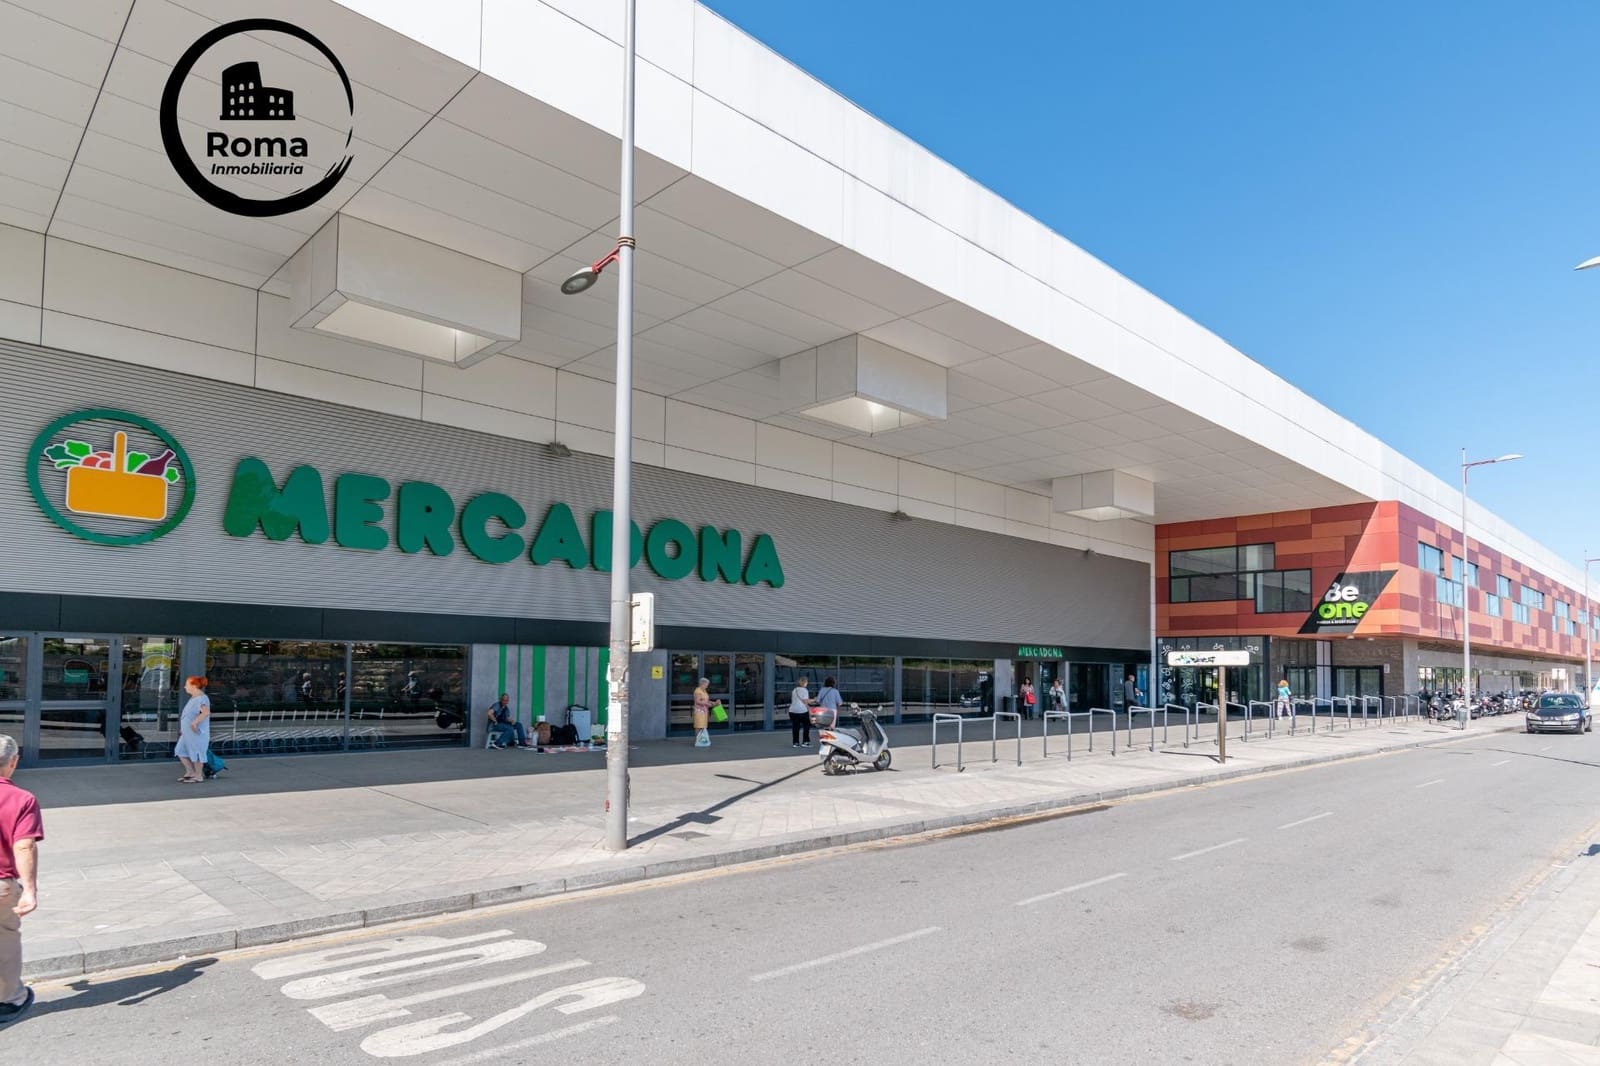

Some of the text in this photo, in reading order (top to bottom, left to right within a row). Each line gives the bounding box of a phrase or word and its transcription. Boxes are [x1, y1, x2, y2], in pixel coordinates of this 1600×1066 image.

[223, 457, 785, 588] MERCADONA
[1318, 601, 1369, 619] one
[1018, 646, 1063, 658] MERCADONA
